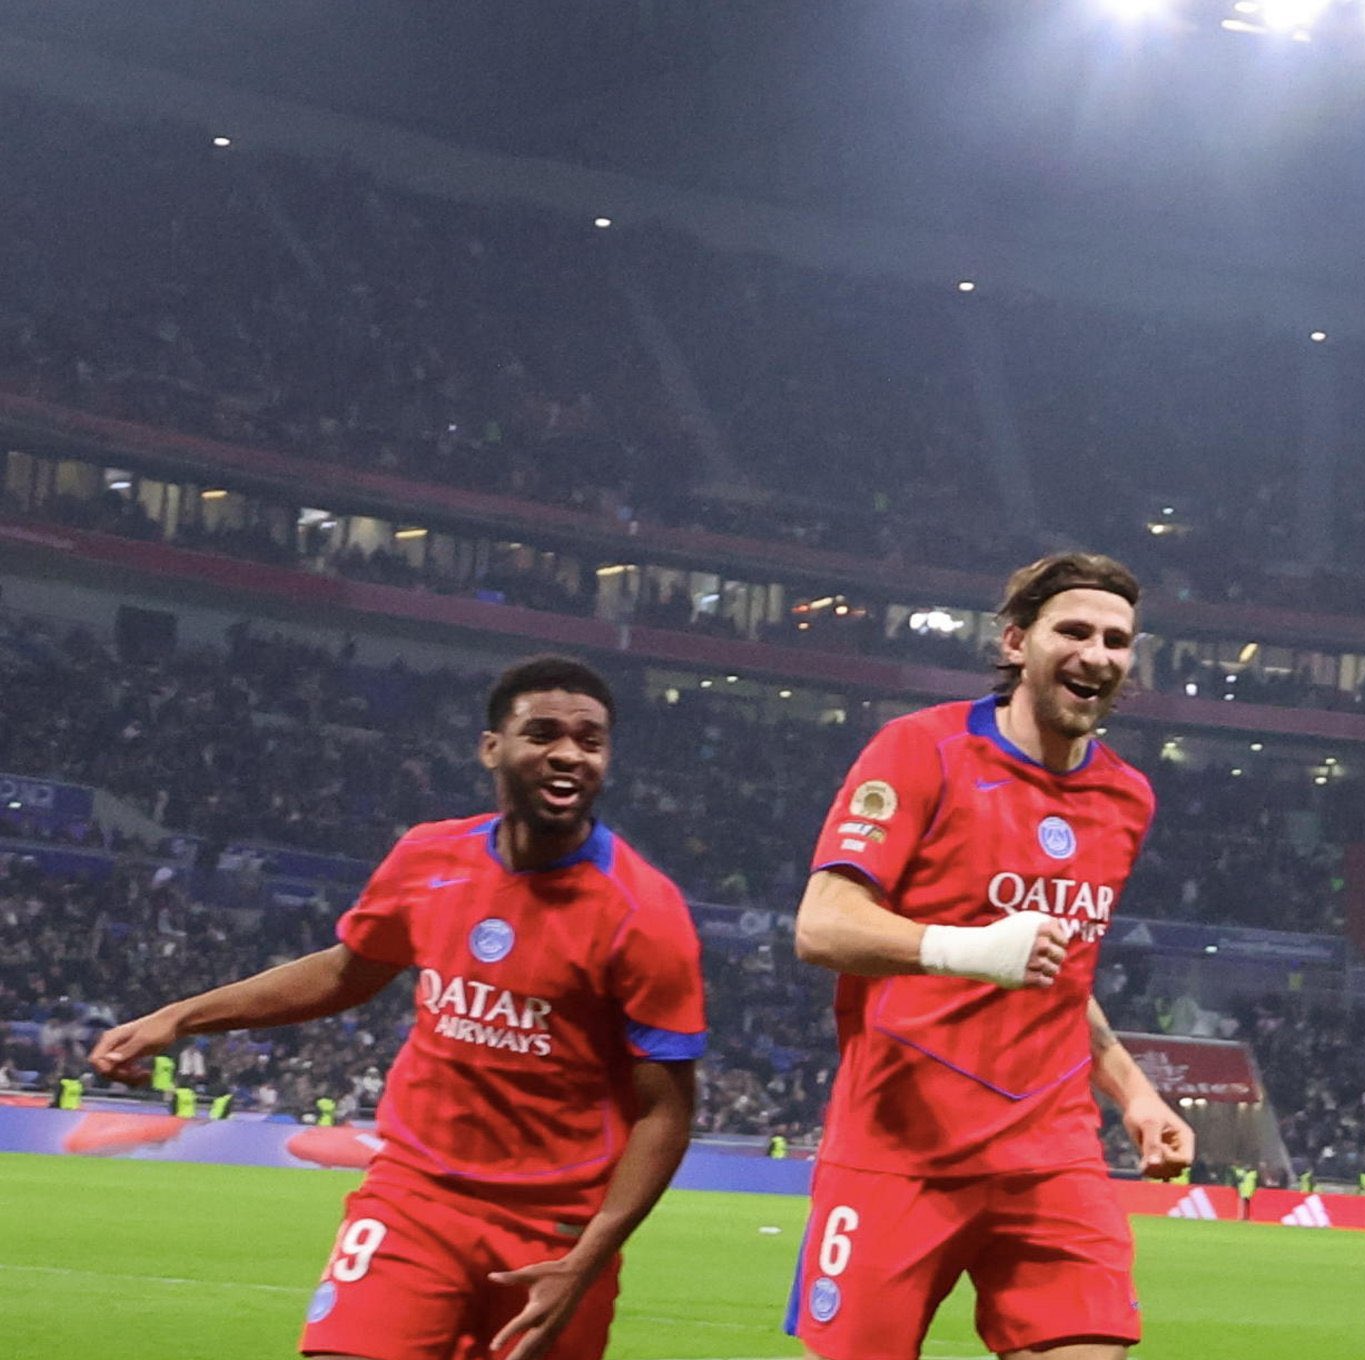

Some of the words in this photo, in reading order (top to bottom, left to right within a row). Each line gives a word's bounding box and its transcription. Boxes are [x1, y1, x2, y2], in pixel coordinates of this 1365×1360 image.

[987, 872, 1114, 922] QATAR
[419, 968, 552, 1030] QATAR
[434, 1014, 551, 1056] AIRWAYS
[322, 1217, 388, 1283] 9
[818, 1205, 859, 1277] 6
